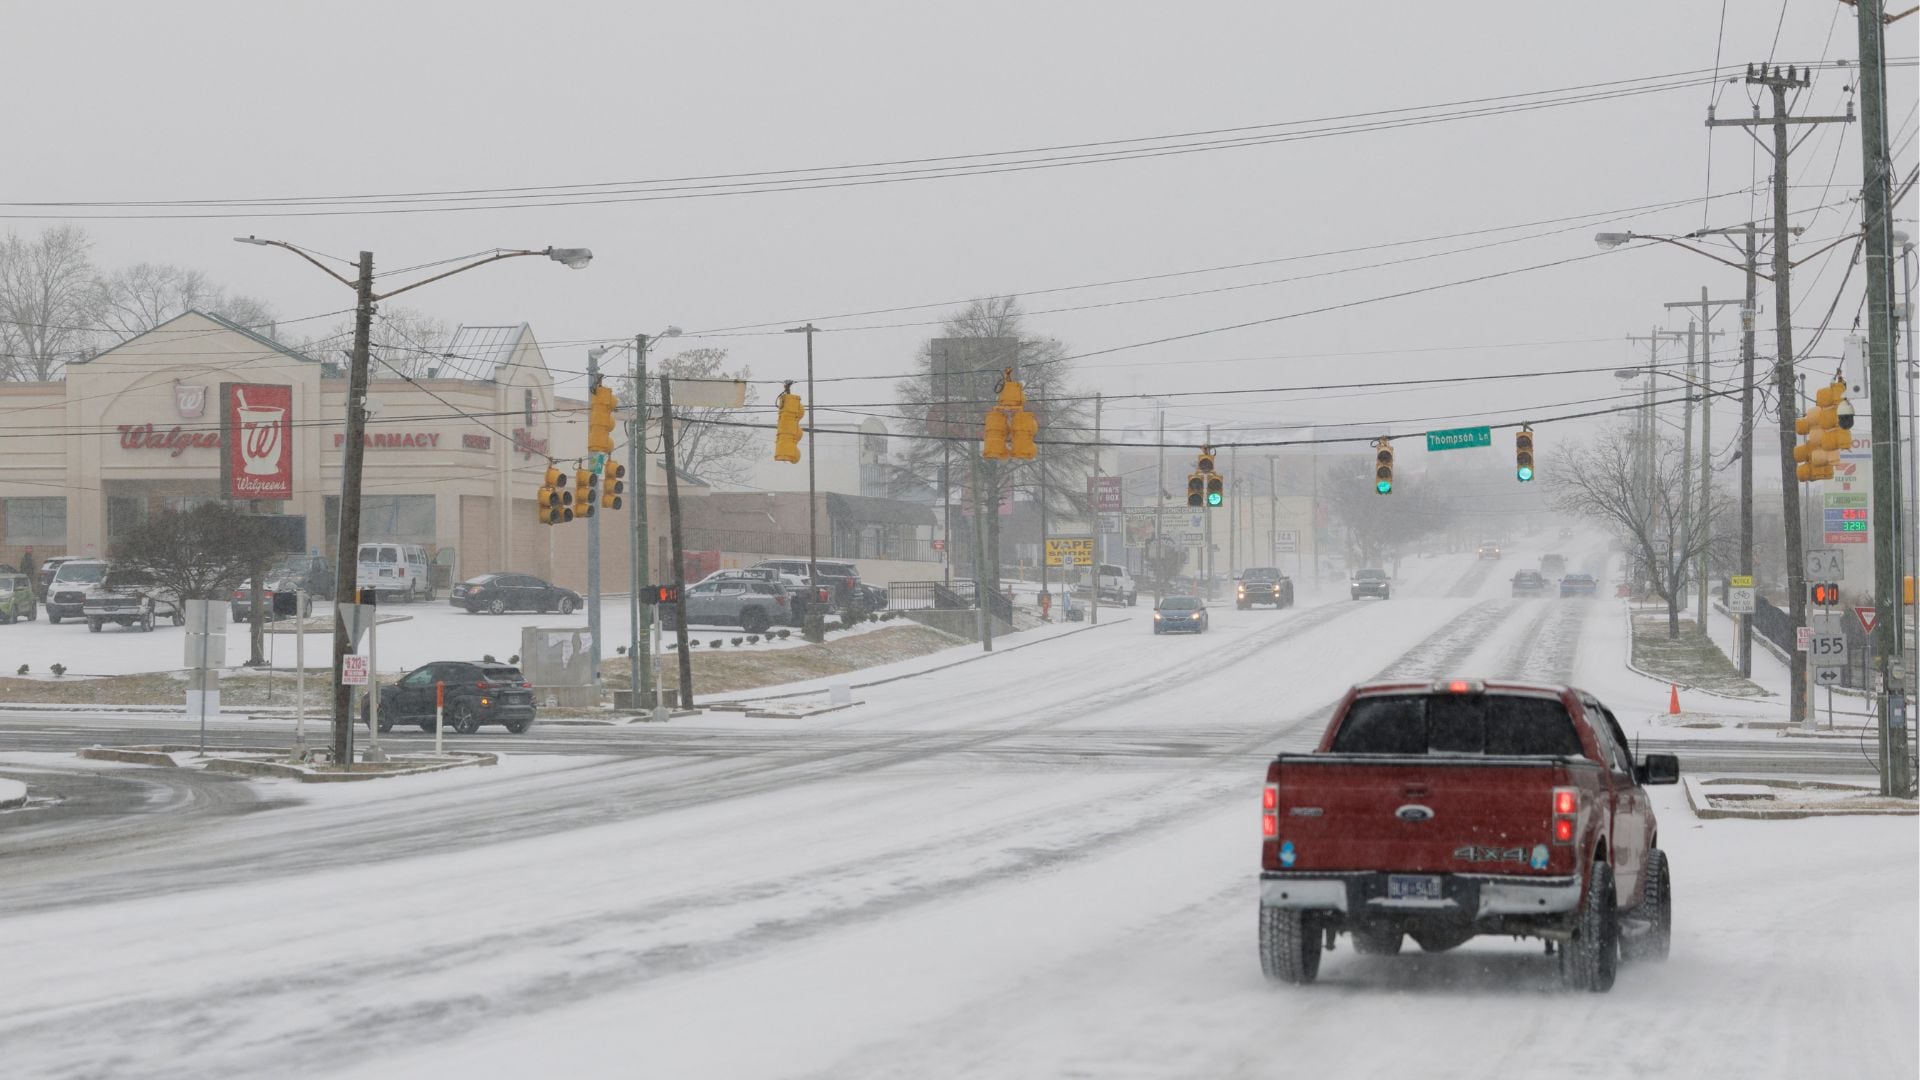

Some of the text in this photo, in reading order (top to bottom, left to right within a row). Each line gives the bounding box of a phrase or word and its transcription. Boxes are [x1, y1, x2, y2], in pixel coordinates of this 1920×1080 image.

[334, 433, 439, 448] PARMACY
[1429, 432, 1488, 446] Thompson Ln
[236, 476, 287, 494] Walgreens
[1050, 540, 1093, 549] VAPE
[1812, 637, 1844, 655] 155
